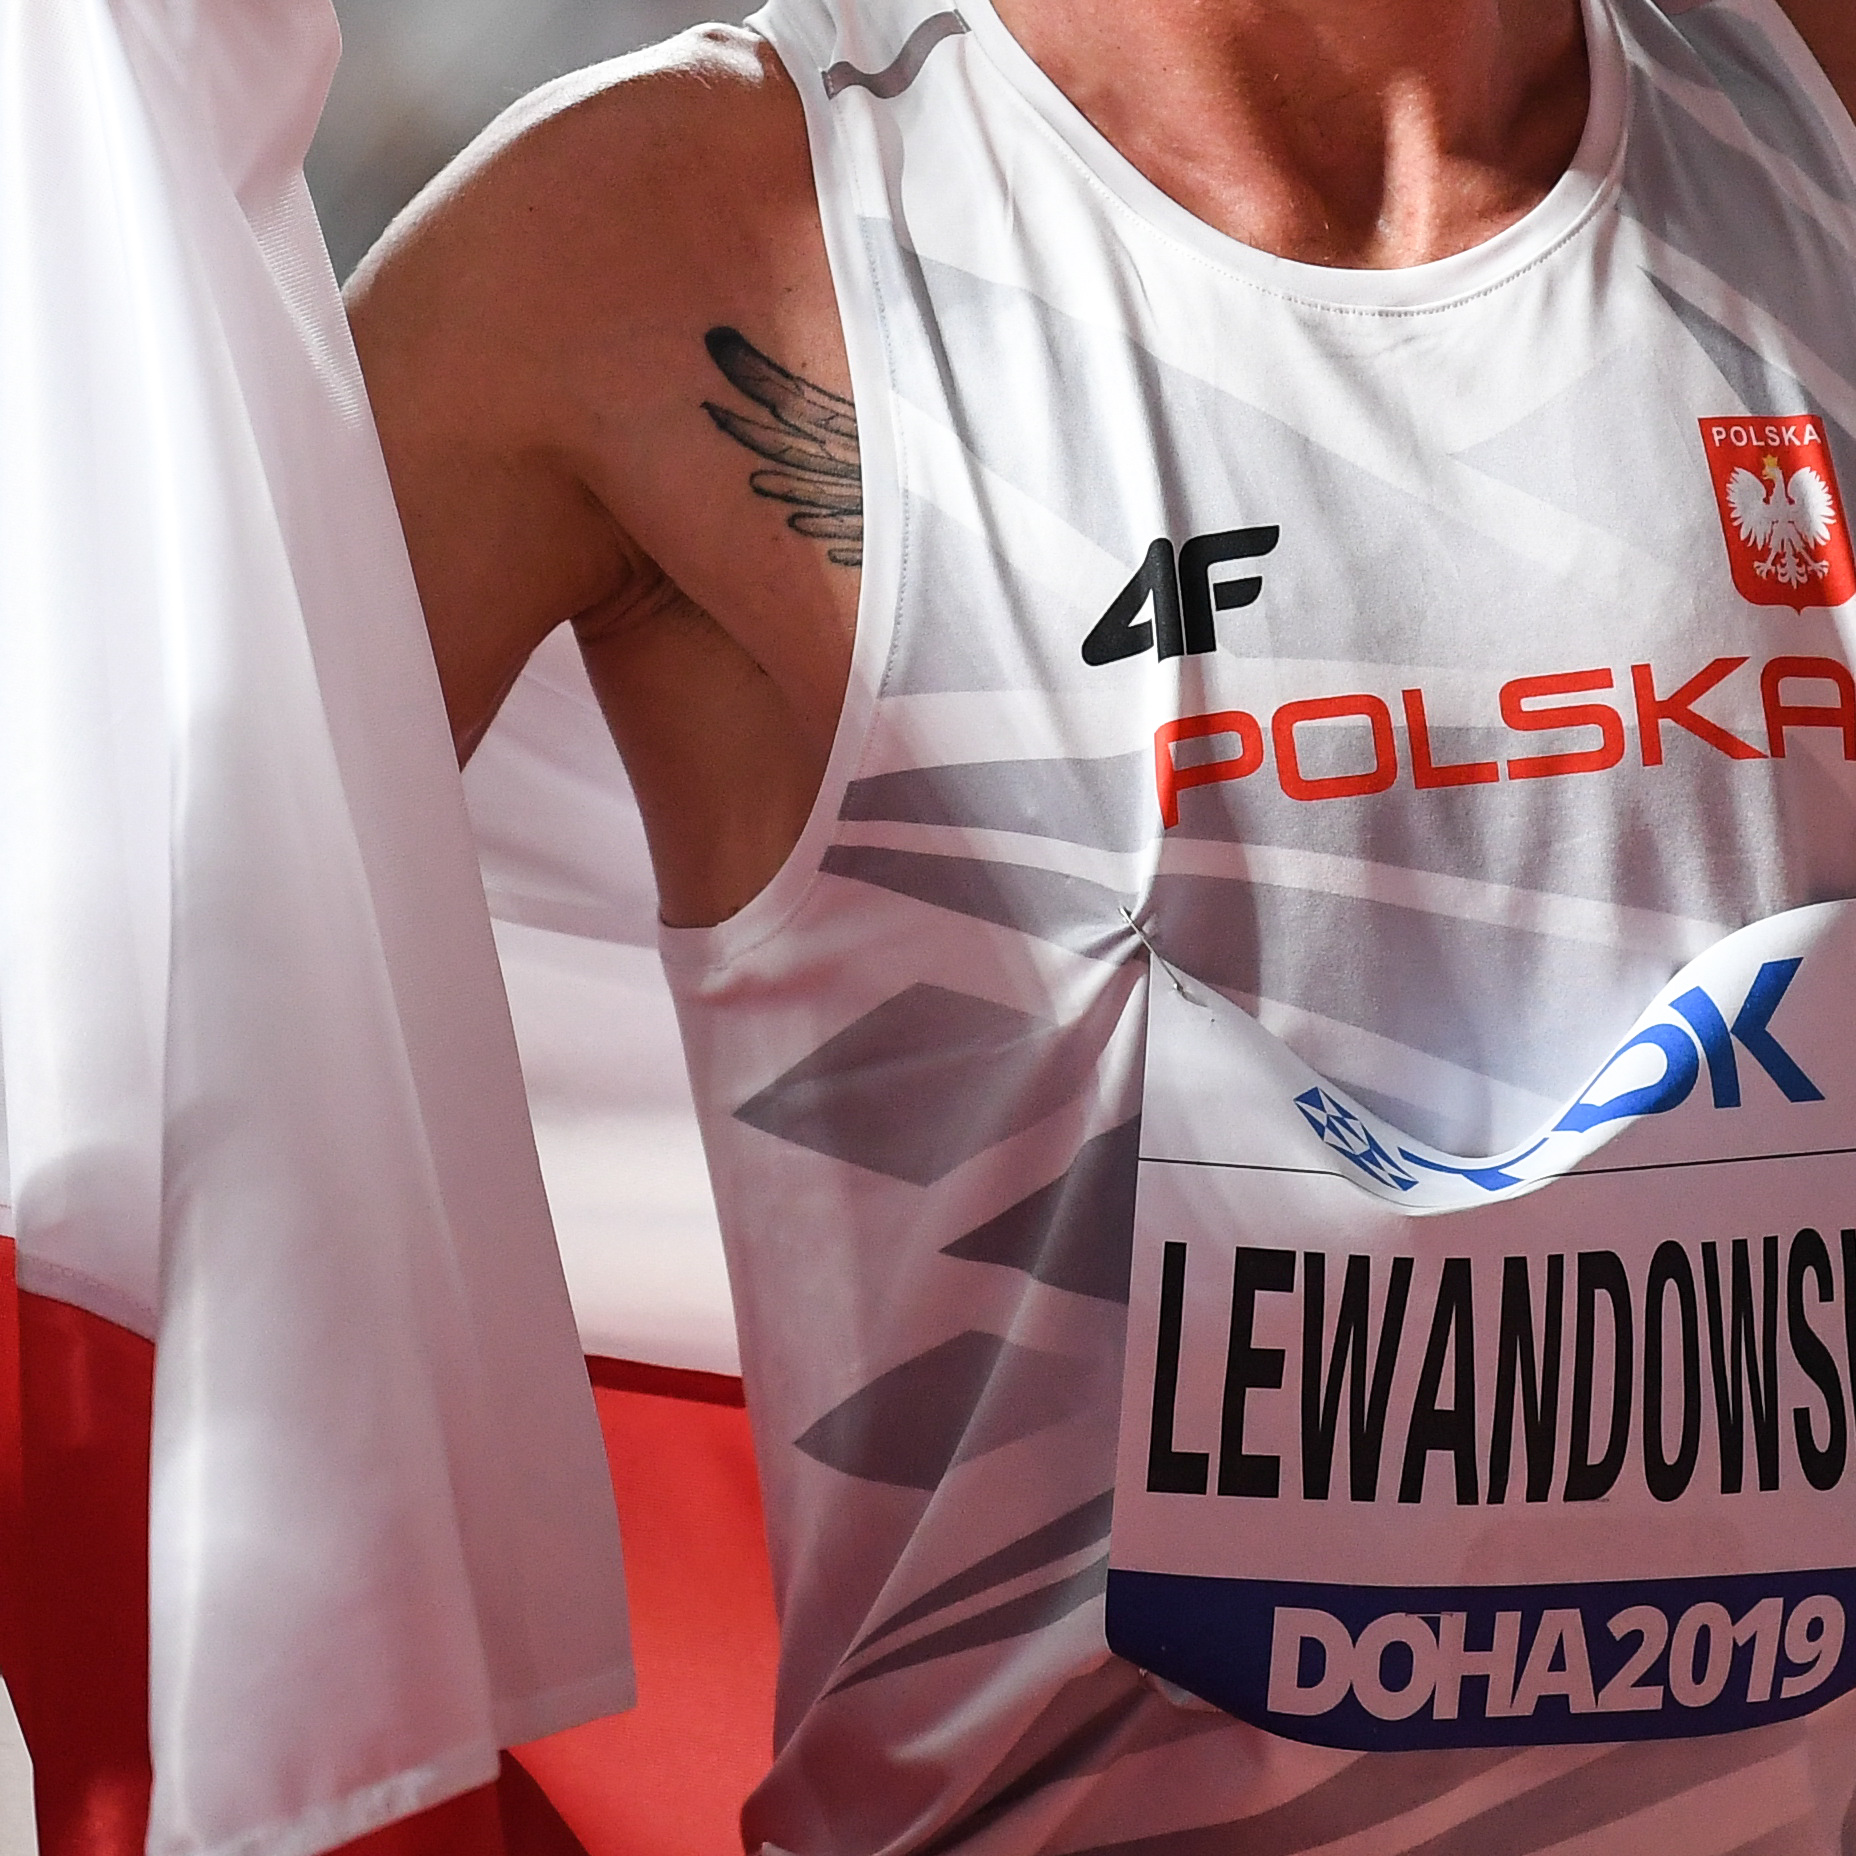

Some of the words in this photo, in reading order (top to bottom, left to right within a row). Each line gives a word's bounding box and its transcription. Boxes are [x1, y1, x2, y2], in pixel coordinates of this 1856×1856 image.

[1711, 423, 1822, 448] POLSKA
[1081, 524, 1281, 667] 4F
[1265, 1594, 1847, 1723] DOHA2019
